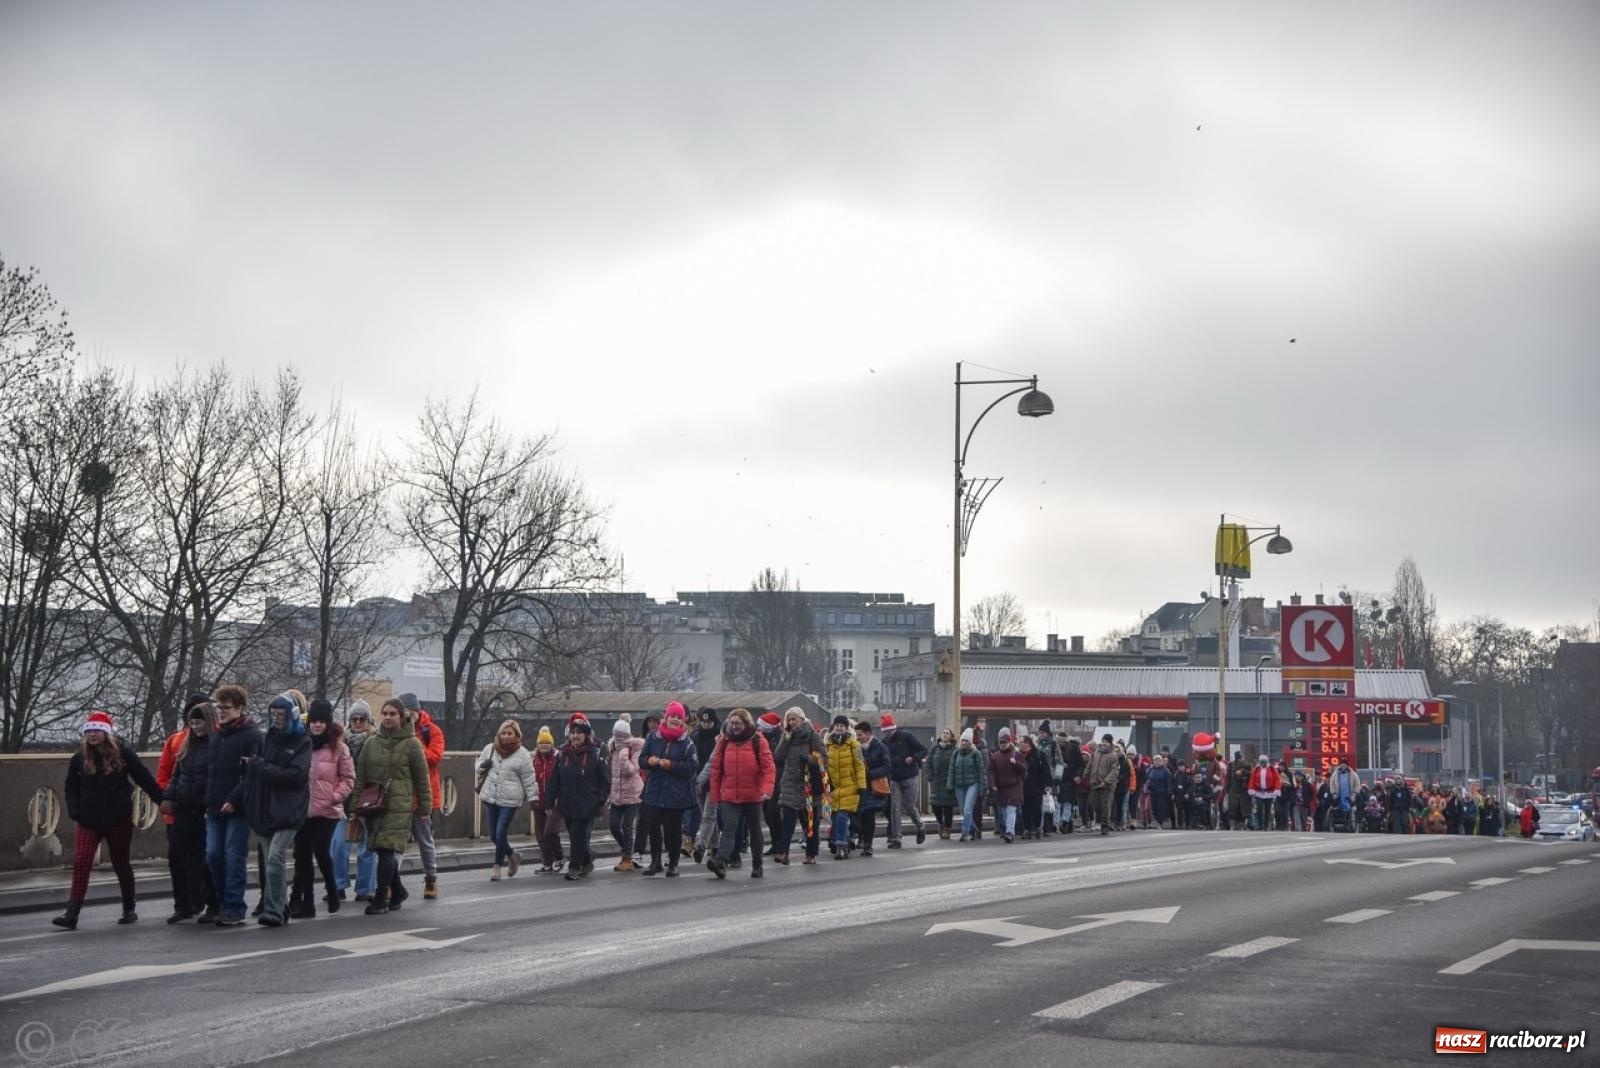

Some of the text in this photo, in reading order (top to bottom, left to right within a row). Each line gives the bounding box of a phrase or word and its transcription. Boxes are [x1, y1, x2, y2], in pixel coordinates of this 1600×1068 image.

[1304, 618, 1340, 659] K
[1321, 712, 1347, 724] 6.07
[1321, 727, 1348, 739] 5.52
[1321, 741, 1348, 753] 6.47
